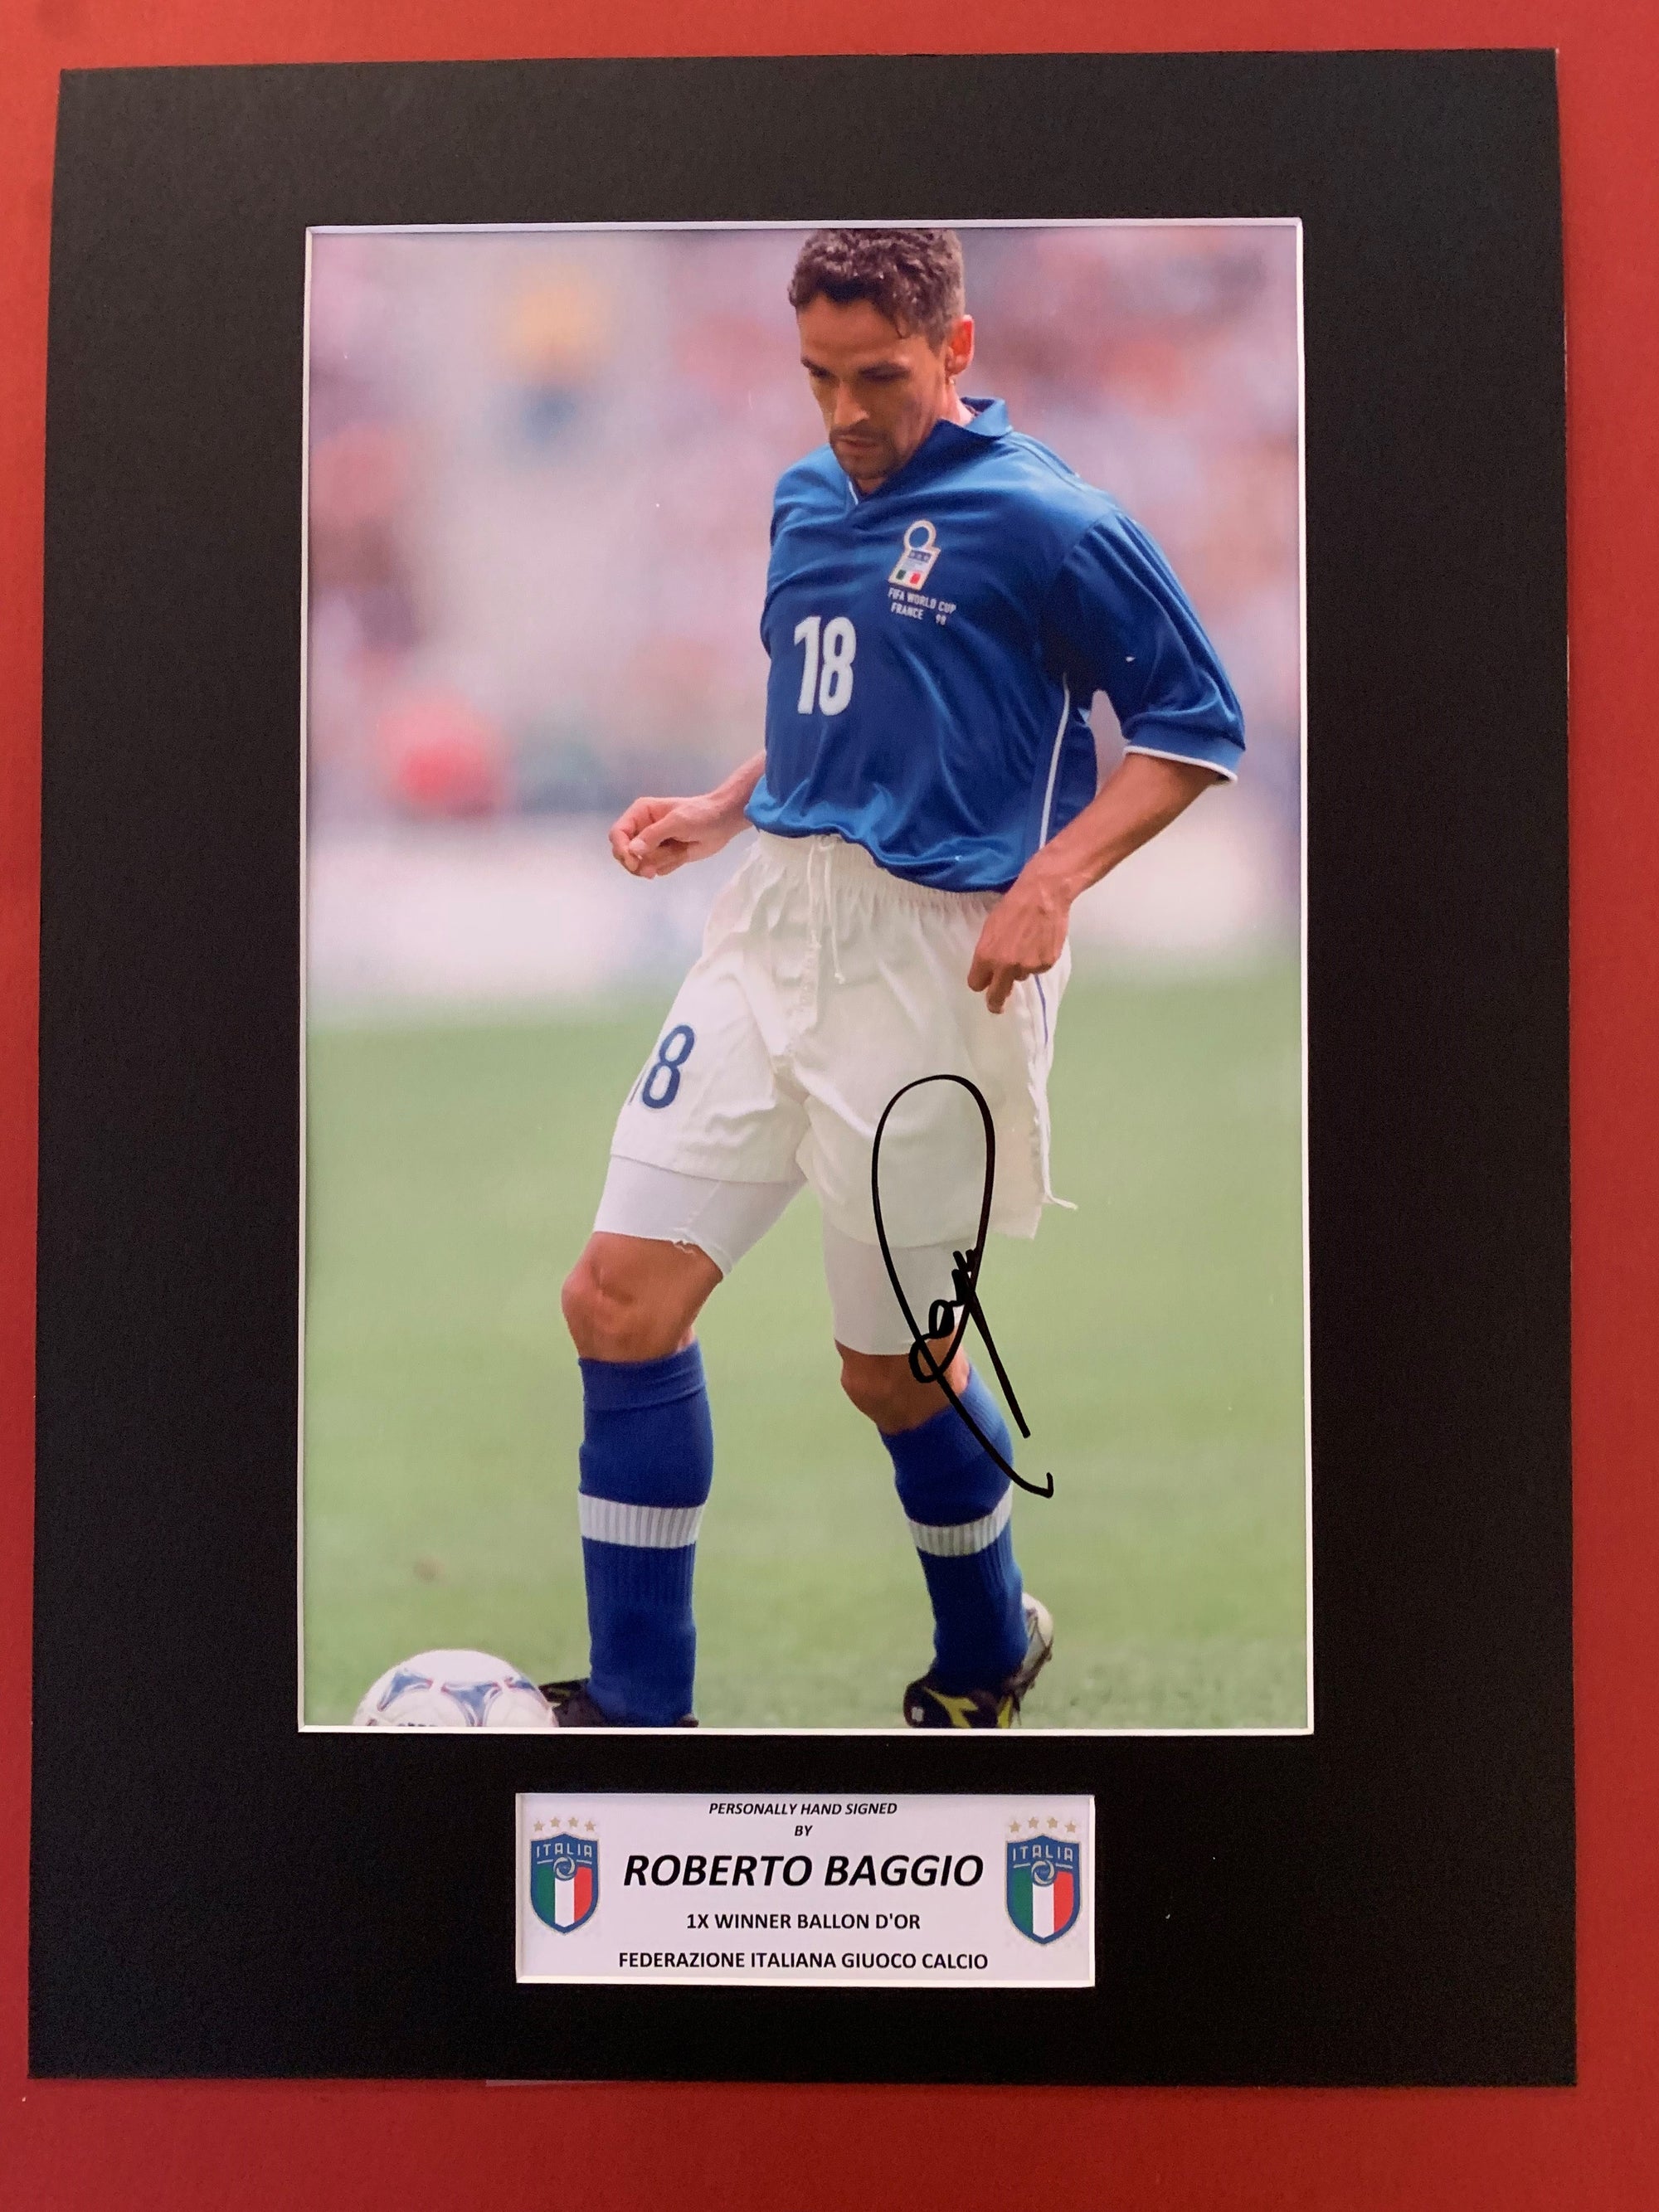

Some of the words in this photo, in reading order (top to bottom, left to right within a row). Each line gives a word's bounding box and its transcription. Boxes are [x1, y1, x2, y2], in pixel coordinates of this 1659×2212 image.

[888, 588, 904, 600] FIFA
[907, 593, 937, 609] WORLD
[938, 601, 956, 614] CUP
[891, 603, 923, 620] FRANCE
[794, 615, 856, 717] 18
[708, 1802, 797, 1816] PERSONALLY
[800, 1803, 842, 1816] HAND
[844, 1802, 898, 1816] SIGNED
[794, 1825, 813, 1836] BY
[536, 1842, 592, 1858] ITALIA
[1013, 1844, 1073, 1862] ITALIA
[623, 1855, 813, 1887] ROBERTO
[824, 1855, 984, 1887] BAGGIO
[687, 1913, 709, 1929] 1X
[714, 1913, 791, 1929] WINNER
[797, 1913, 869, 1929] BALLON
[875, 1913, 921, 1929] D'OR
[619, 1952, 745, 1968] FEDERAZIONE
[751, 1952, 837, 1968] ITALIANA
[841, 1952, 917, 1969] GIUOCO
[922, 1953, 988, 1970] CALCIO
